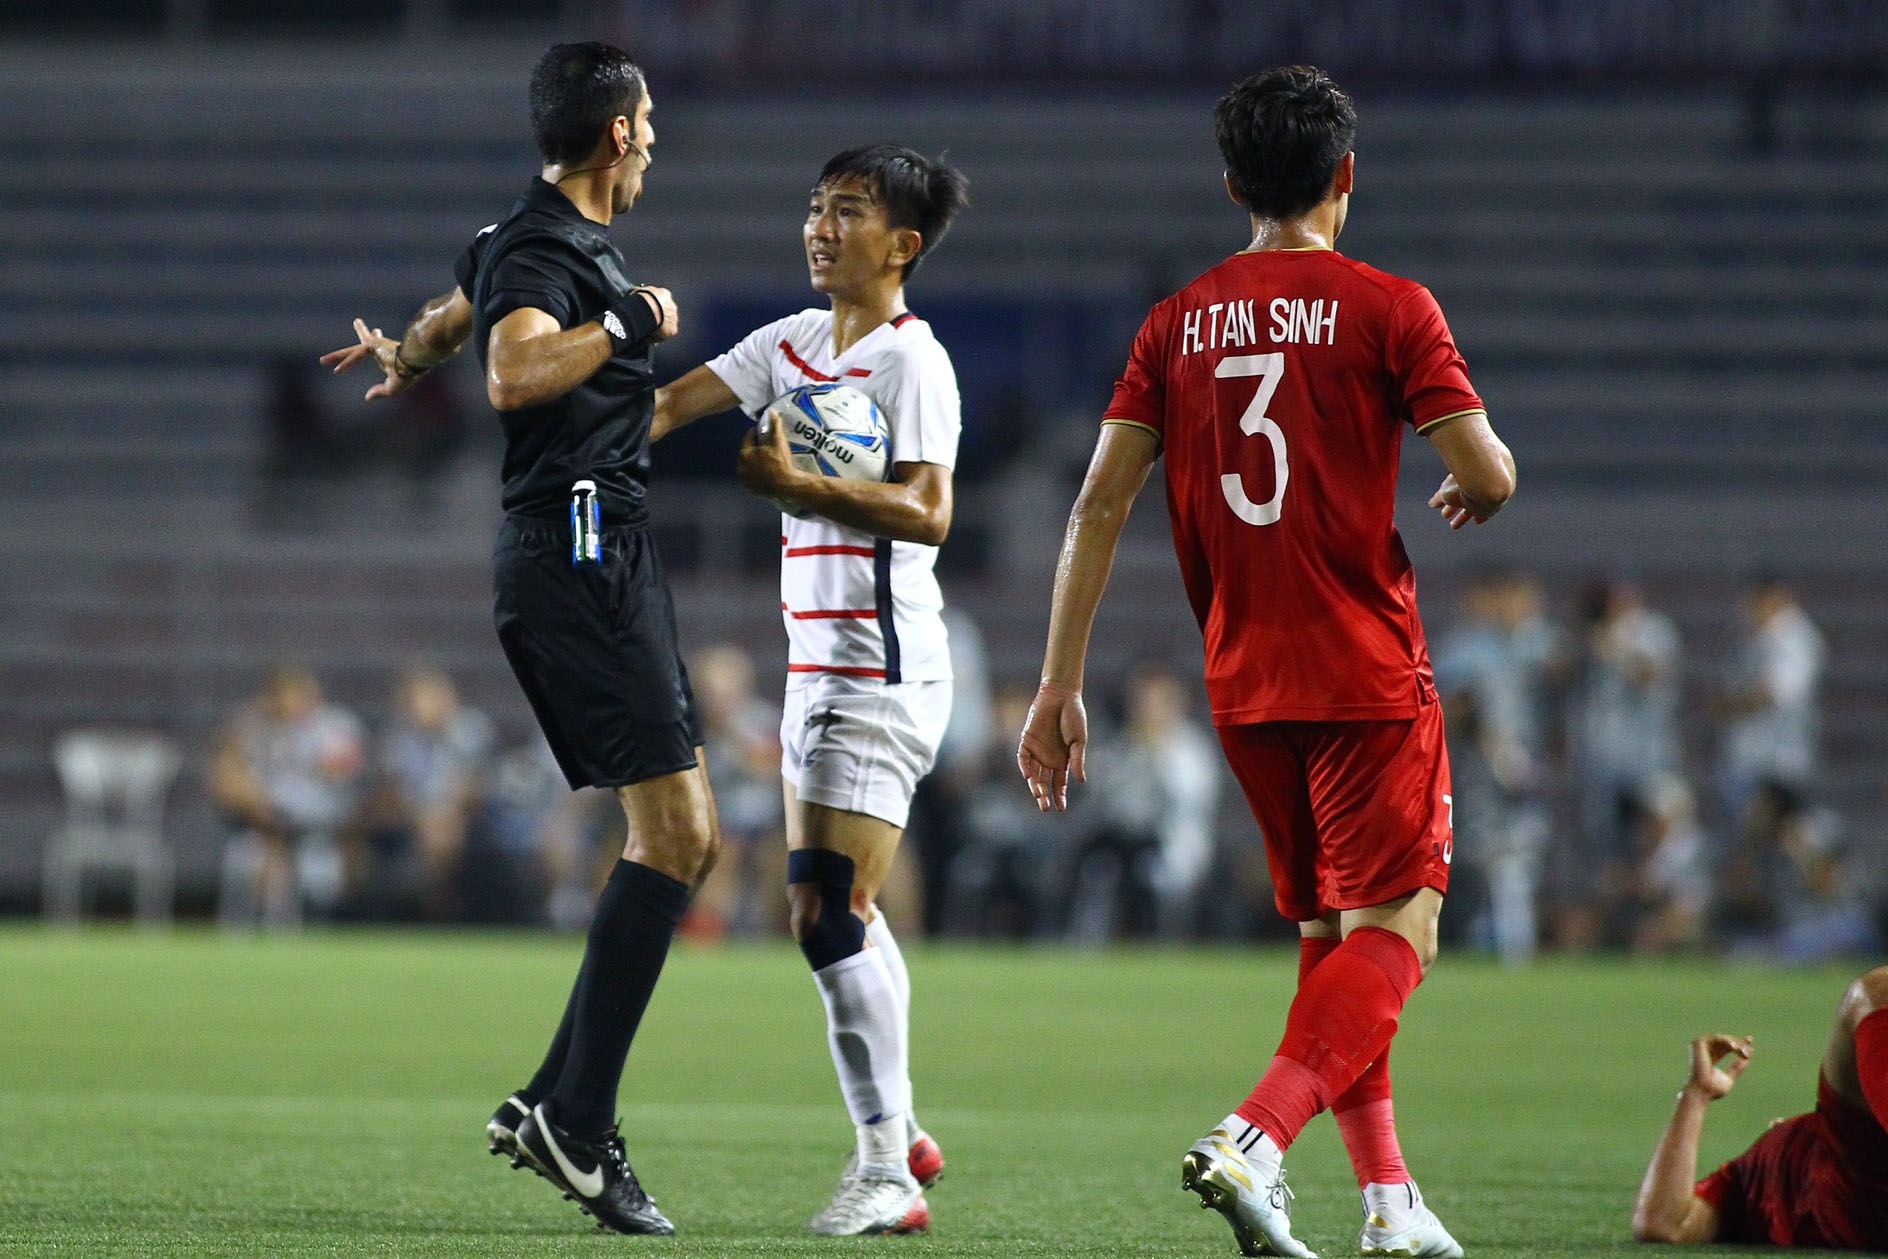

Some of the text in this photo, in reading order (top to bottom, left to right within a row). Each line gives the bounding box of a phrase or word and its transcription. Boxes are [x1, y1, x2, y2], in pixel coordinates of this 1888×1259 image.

[1182, 297, 1339, 356] H.TAN SINH
[794, 420, 855, 464] molten
[1215, 352, 1289, 526] 3
